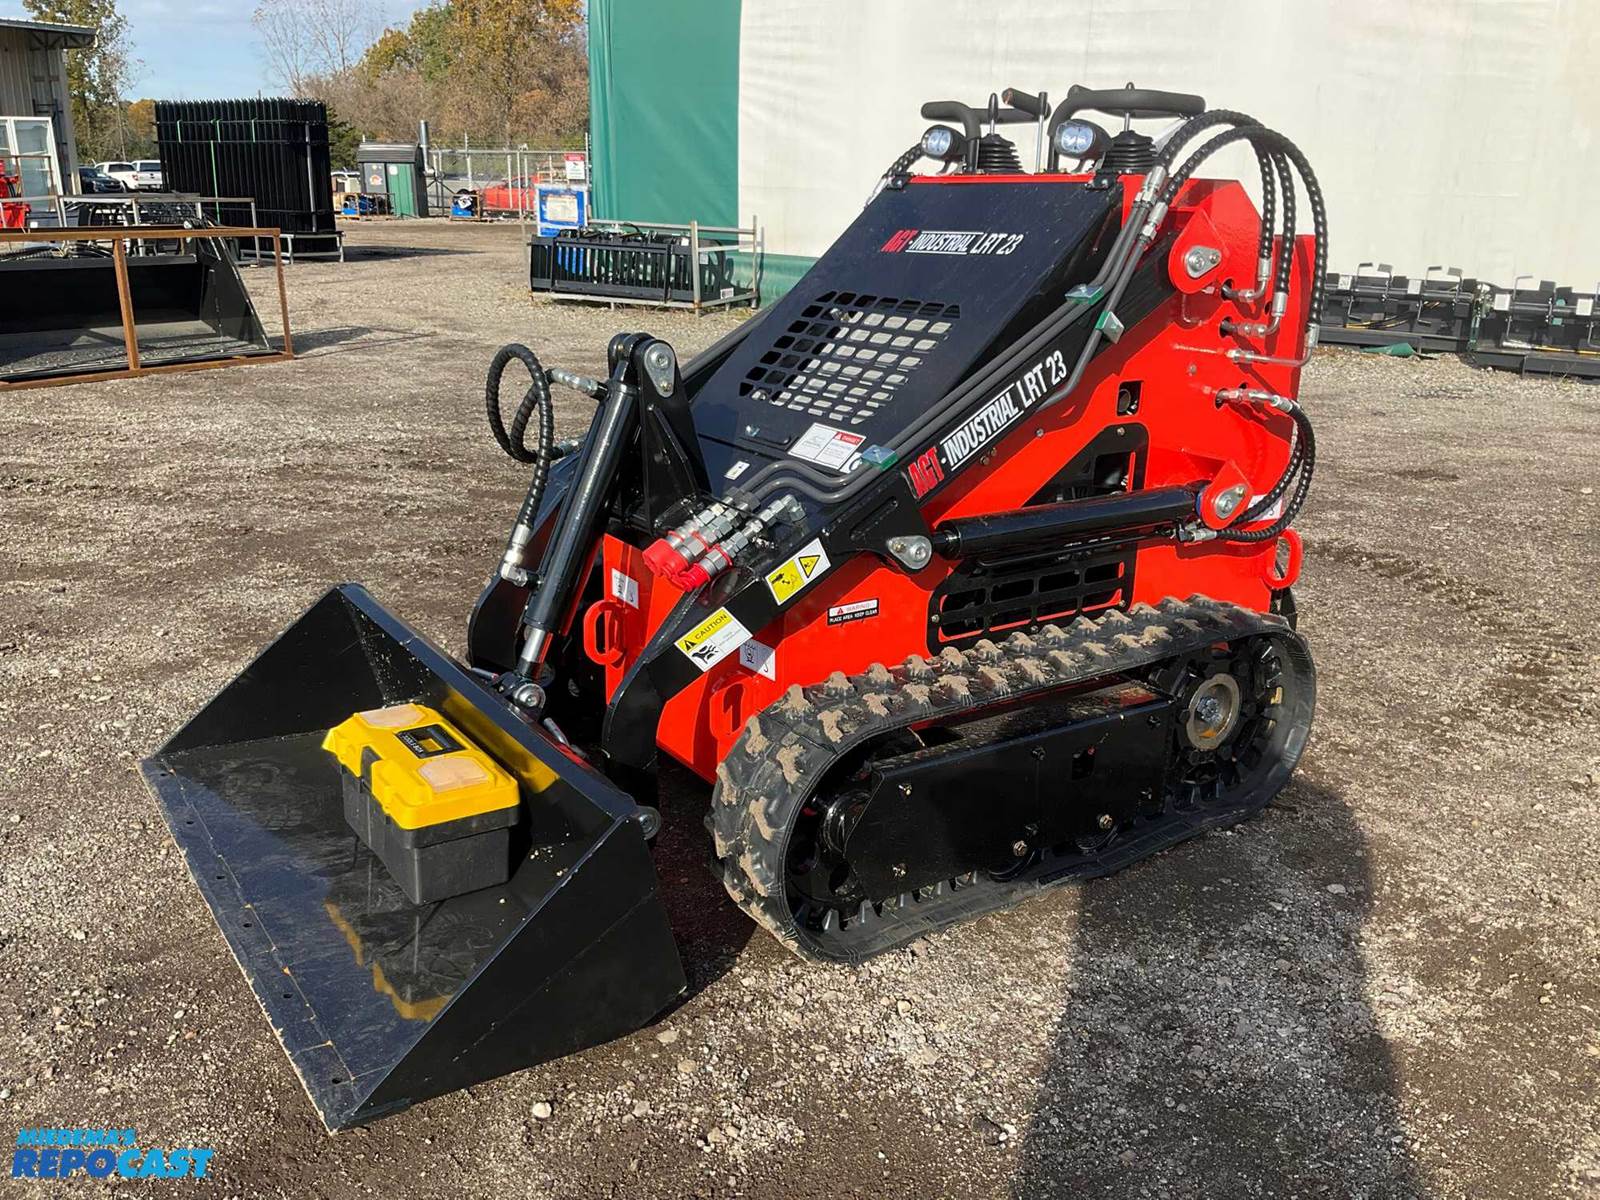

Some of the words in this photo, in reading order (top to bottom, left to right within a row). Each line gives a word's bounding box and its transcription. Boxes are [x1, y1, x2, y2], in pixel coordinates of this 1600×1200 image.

[970, 233, 1008, 255] LRT
[996, 233, 1025, 255] 23
[943, 391, 1019, 467] INDUSTRIAL
[1015, 362, 1048, 409] LRT
[1045, 349, 1068, 387] 23
[694, 613, 728, 640] CAUTION
